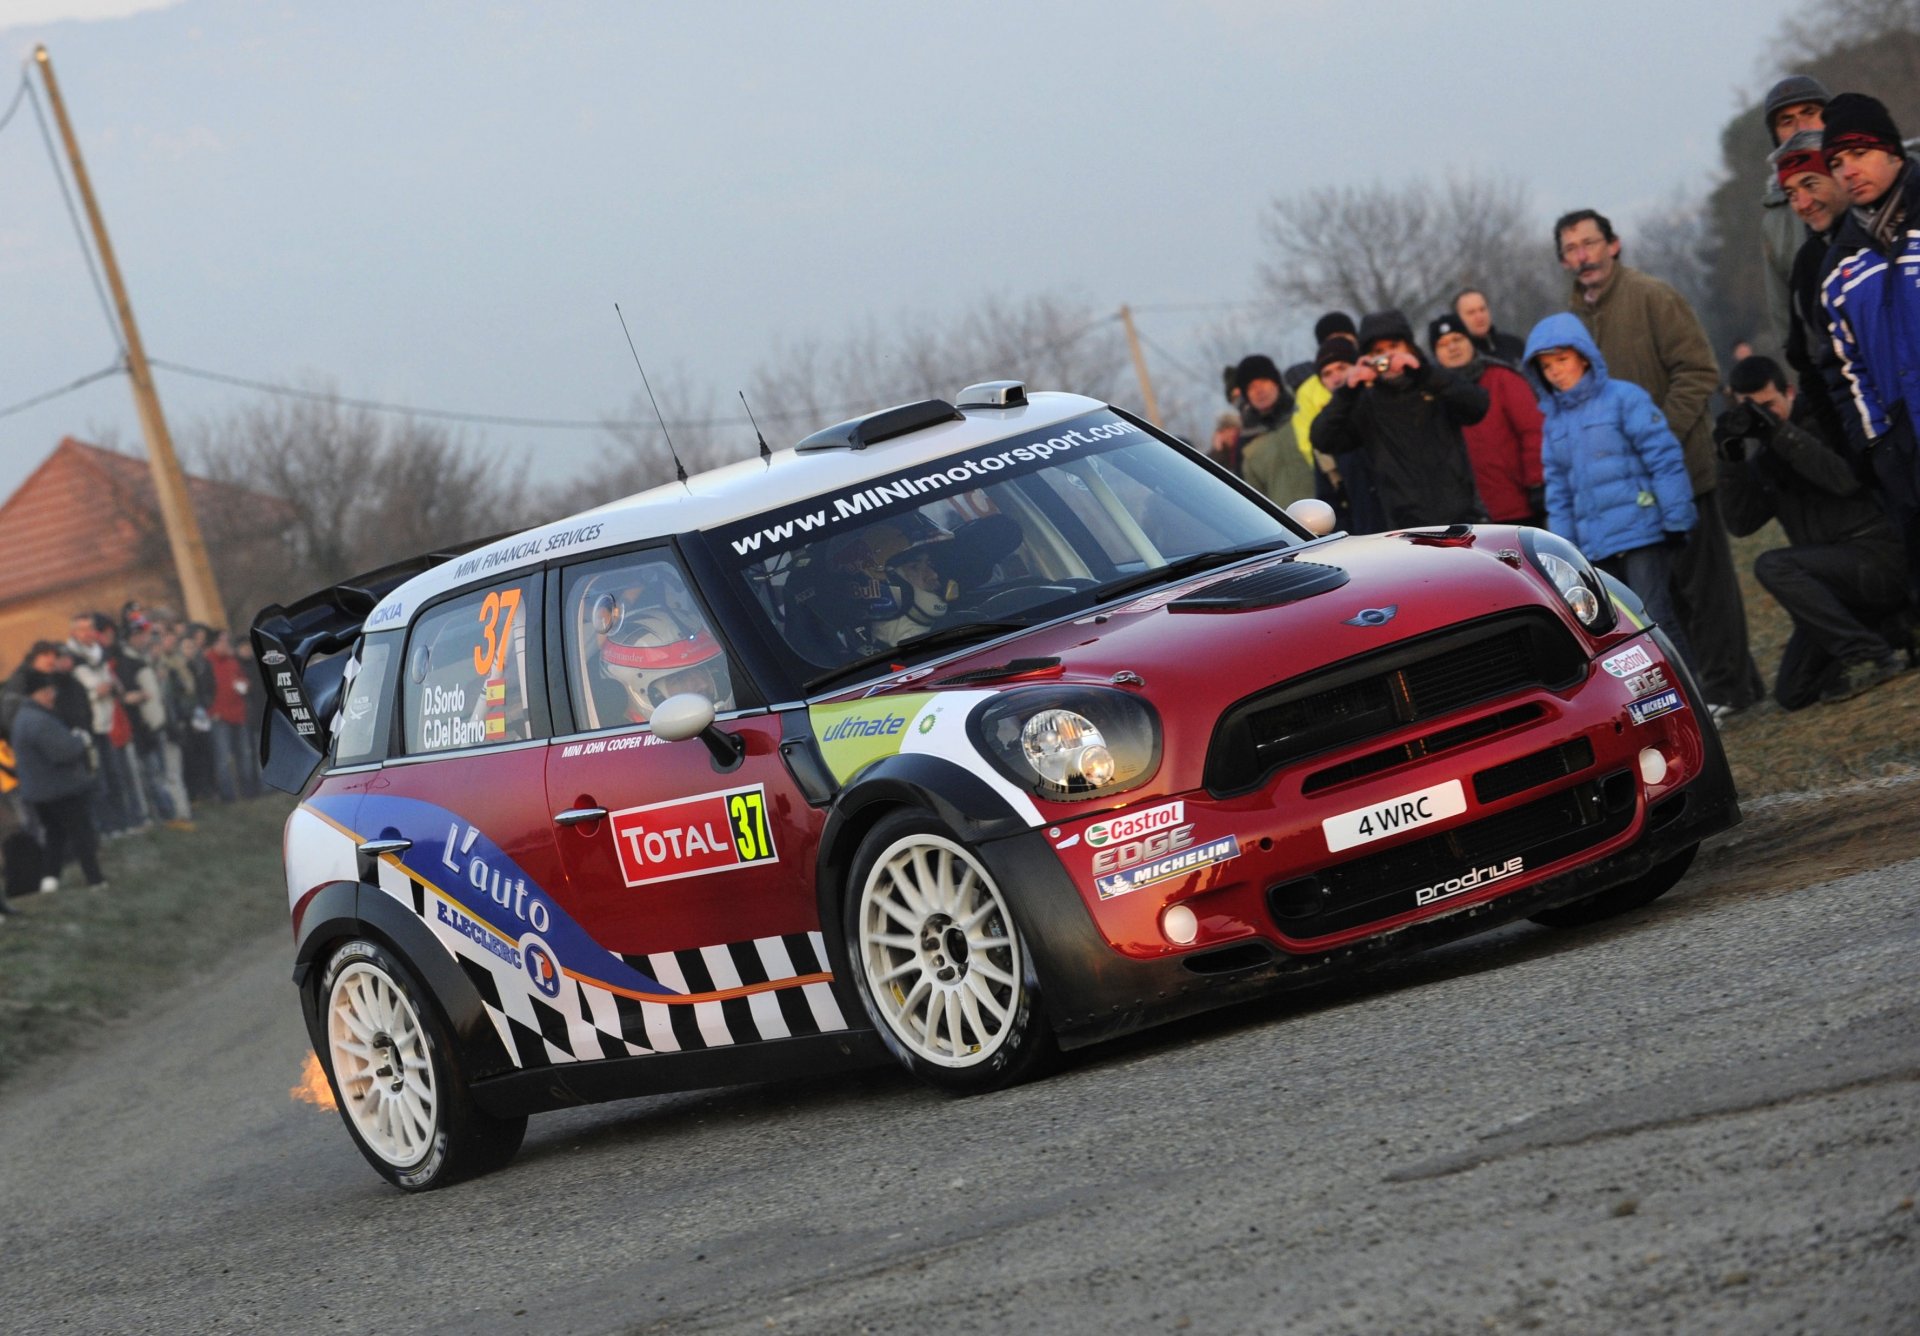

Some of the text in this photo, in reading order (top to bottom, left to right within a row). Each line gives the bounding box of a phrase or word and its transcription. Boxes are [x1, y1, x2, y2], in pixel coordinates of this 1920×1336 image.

[730, 421, 1138, 556] www.MINImotorsport.com
[454, 523, 604, 579] MINI FINANCIAL SERVICES
[474, 588, 522, 675] 37
[1614, 648, 1650, 672] Castrol
[424, 683, 465, 715] D.Sordo
[1624, 667, 1668, 698] EDGE
[291, 708, 310, 720] PIAA
[1641, 693, 1677, 715] MICHELIN
[424, 715, 486, 749] C.Del Barrio
[823, 713, 905, 742] ultimate
[562, 746, 582, 758] MINI
[583, 740, 605, 755] JOHN
[607, 737, 642, 752] COOPER
[731, 794, 769, 860] 37
[1111, 805, 1178, 840] Castrol
[1359, 796, 1433, 836] 4 WRC
[1092, 823, 1195, 876] EDGE
[1134, 841, 1231, 883] MICHELIN
[442, 823, 549, 933] L'auto
[1416, 856, 1524, 906] prodrive
